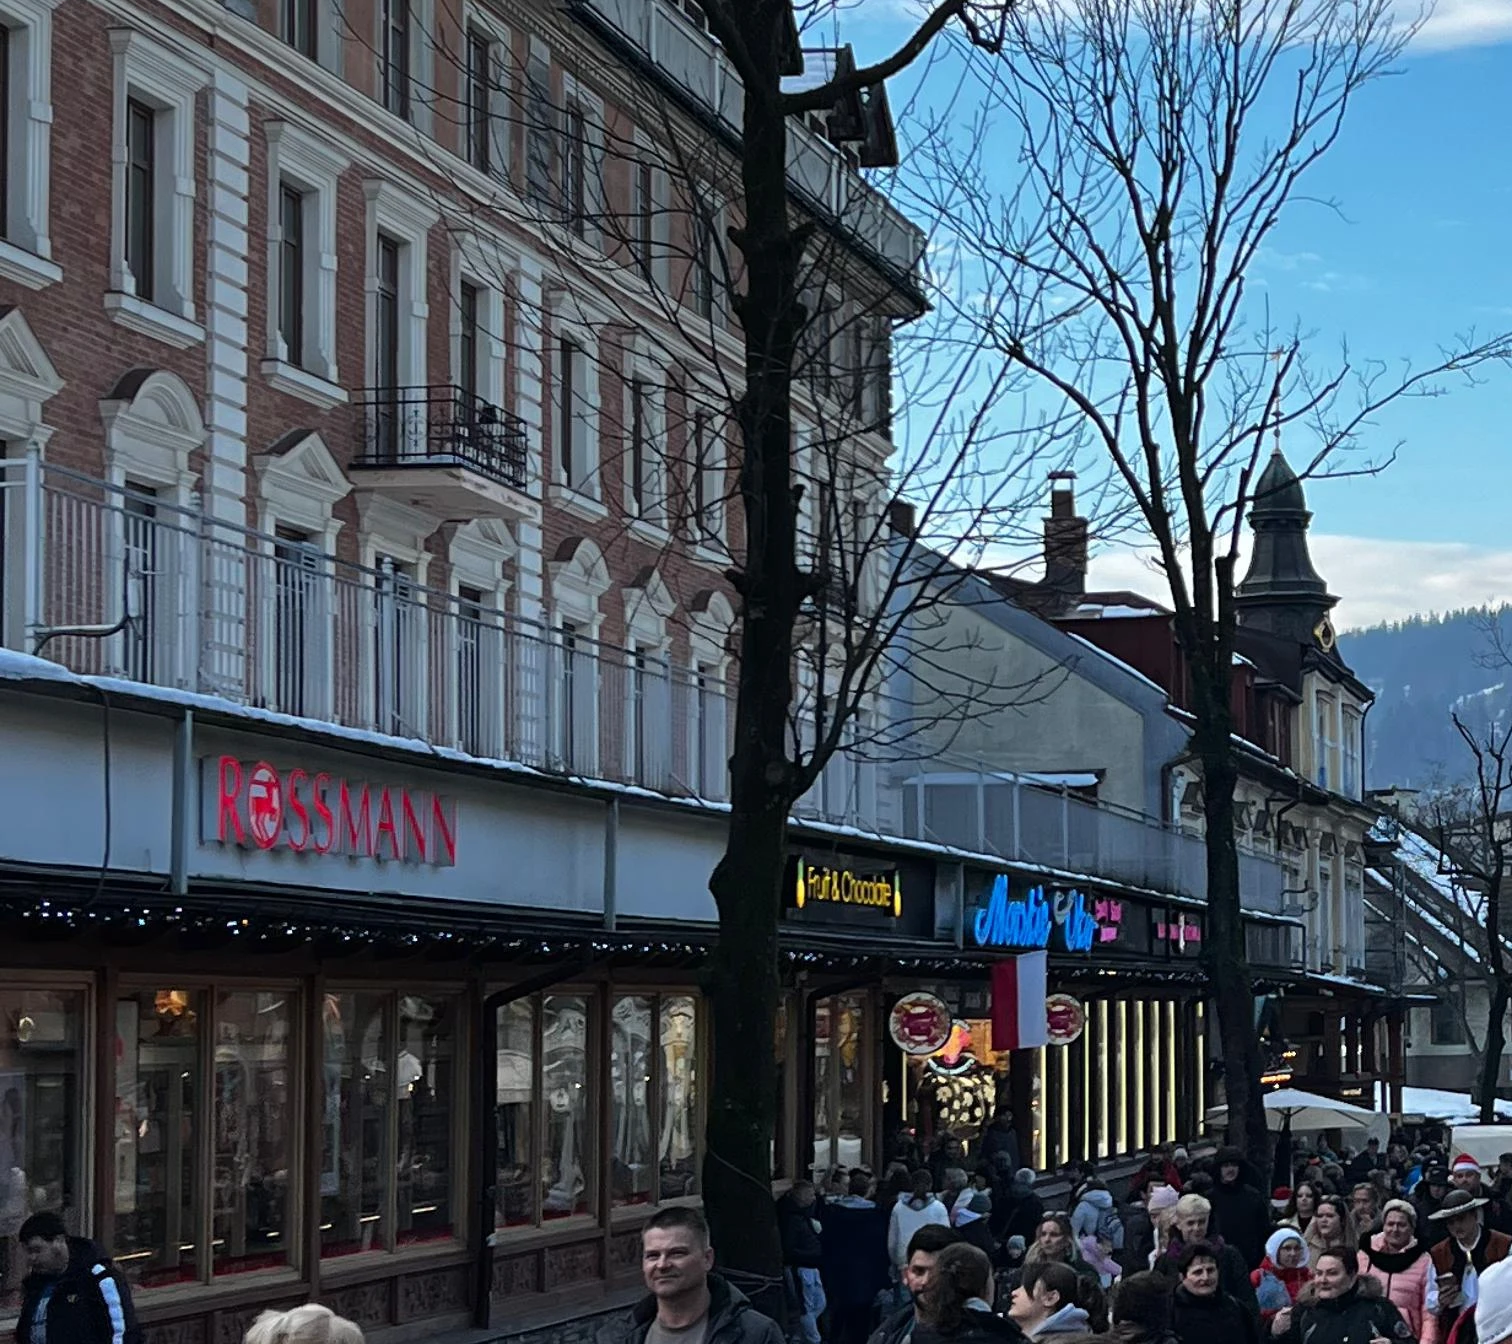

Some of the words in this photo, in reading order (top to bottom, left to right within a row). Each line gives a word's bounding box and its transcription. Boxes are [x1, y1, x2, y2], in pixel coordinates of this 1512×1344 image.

[217, 754, 458, 867] ROSSMANN
[807, 865, 832, 900] Fruit
[831, 870, 841, 902] &
[841, 870, 892, 907] Chocolate
